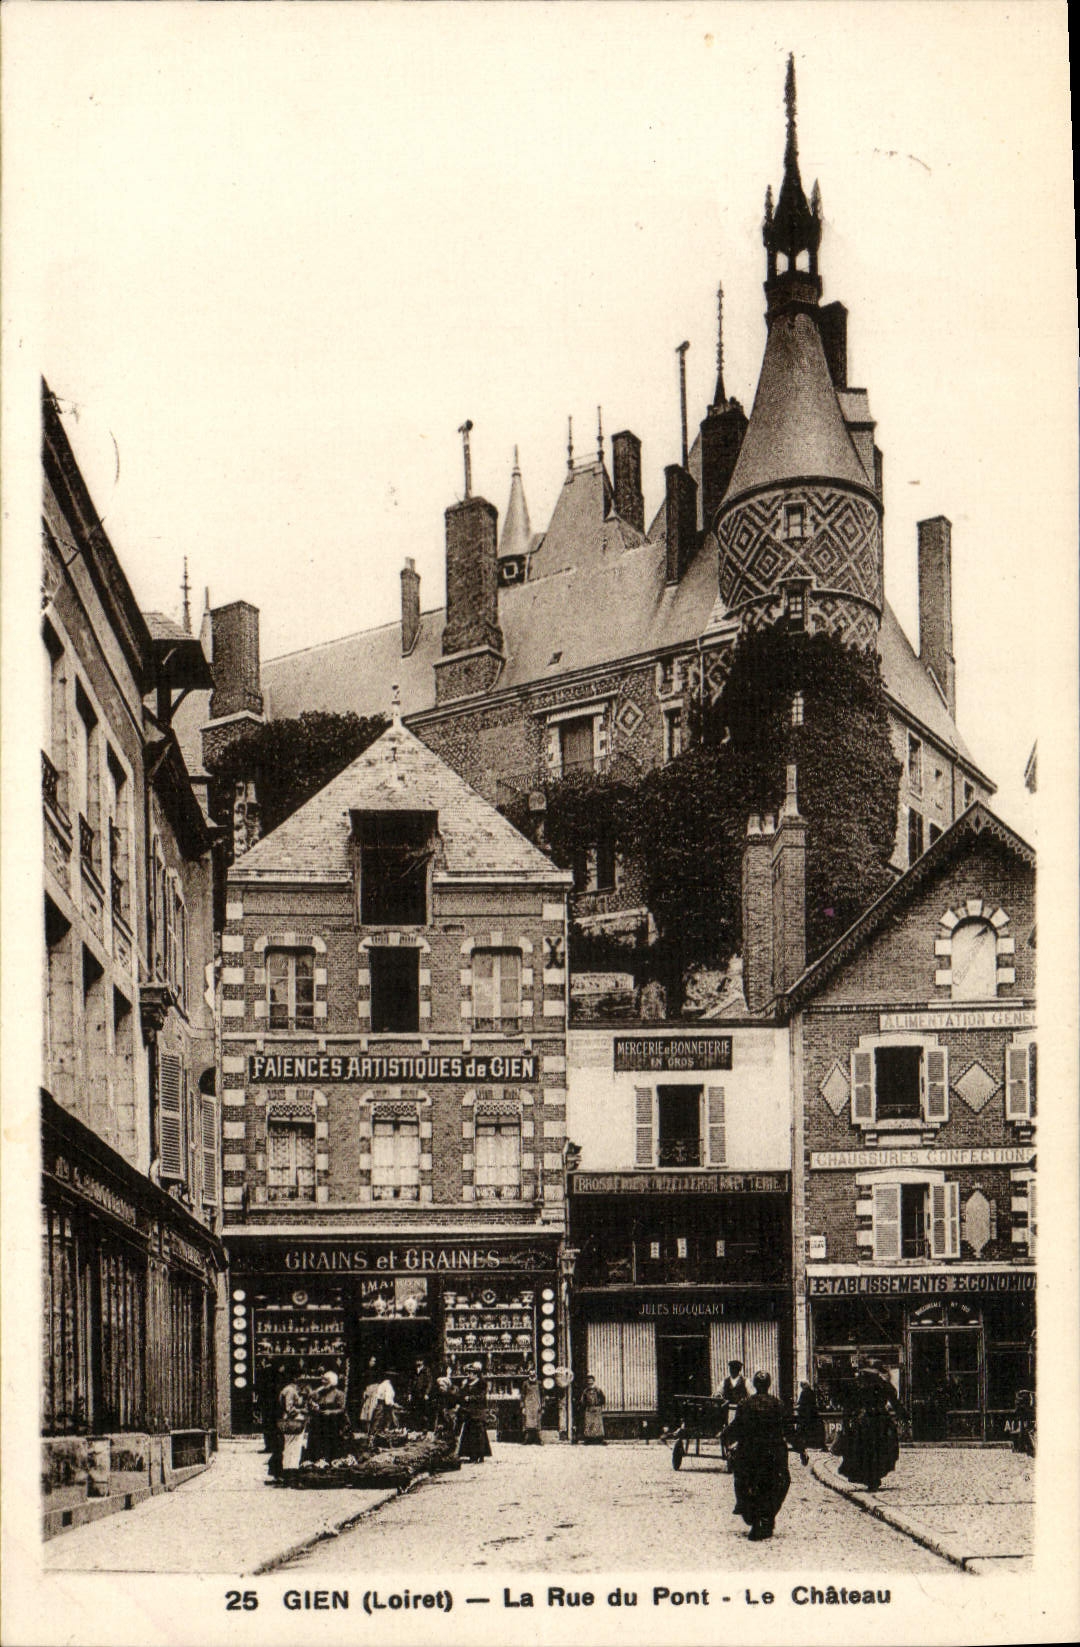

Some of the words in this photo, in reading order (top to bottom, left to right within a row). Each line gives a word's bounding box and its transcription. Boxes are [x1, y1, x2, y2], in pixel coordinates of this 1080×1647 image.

[884, 1012, 985, 1028] ALIMENTATION
[617, 1041, 664, 1056] MERCERIE
[670, 1040, 731, 1055] BONNETERIE
[344, 1057, 462, 1080] ARTISTIQUES
[465, 1058, 487, 1077] de
[490, 1057, 533, 1077] GIEN
[668, 1058, 694, 1068] GROS
[816, 1152, 919, 1167] CHAUSSURES
[285, 1250, 368, 1270] GRAINS
[376, 1251, 398, 1269] et
[405, 1249, 500, 1270] GRAINES
[813, 1275, 948, 1294] ETABLISSEMENTS
[638, 1303, 669, 1316] JULES
[673, 1303, 724, 1316] HOCQUART
